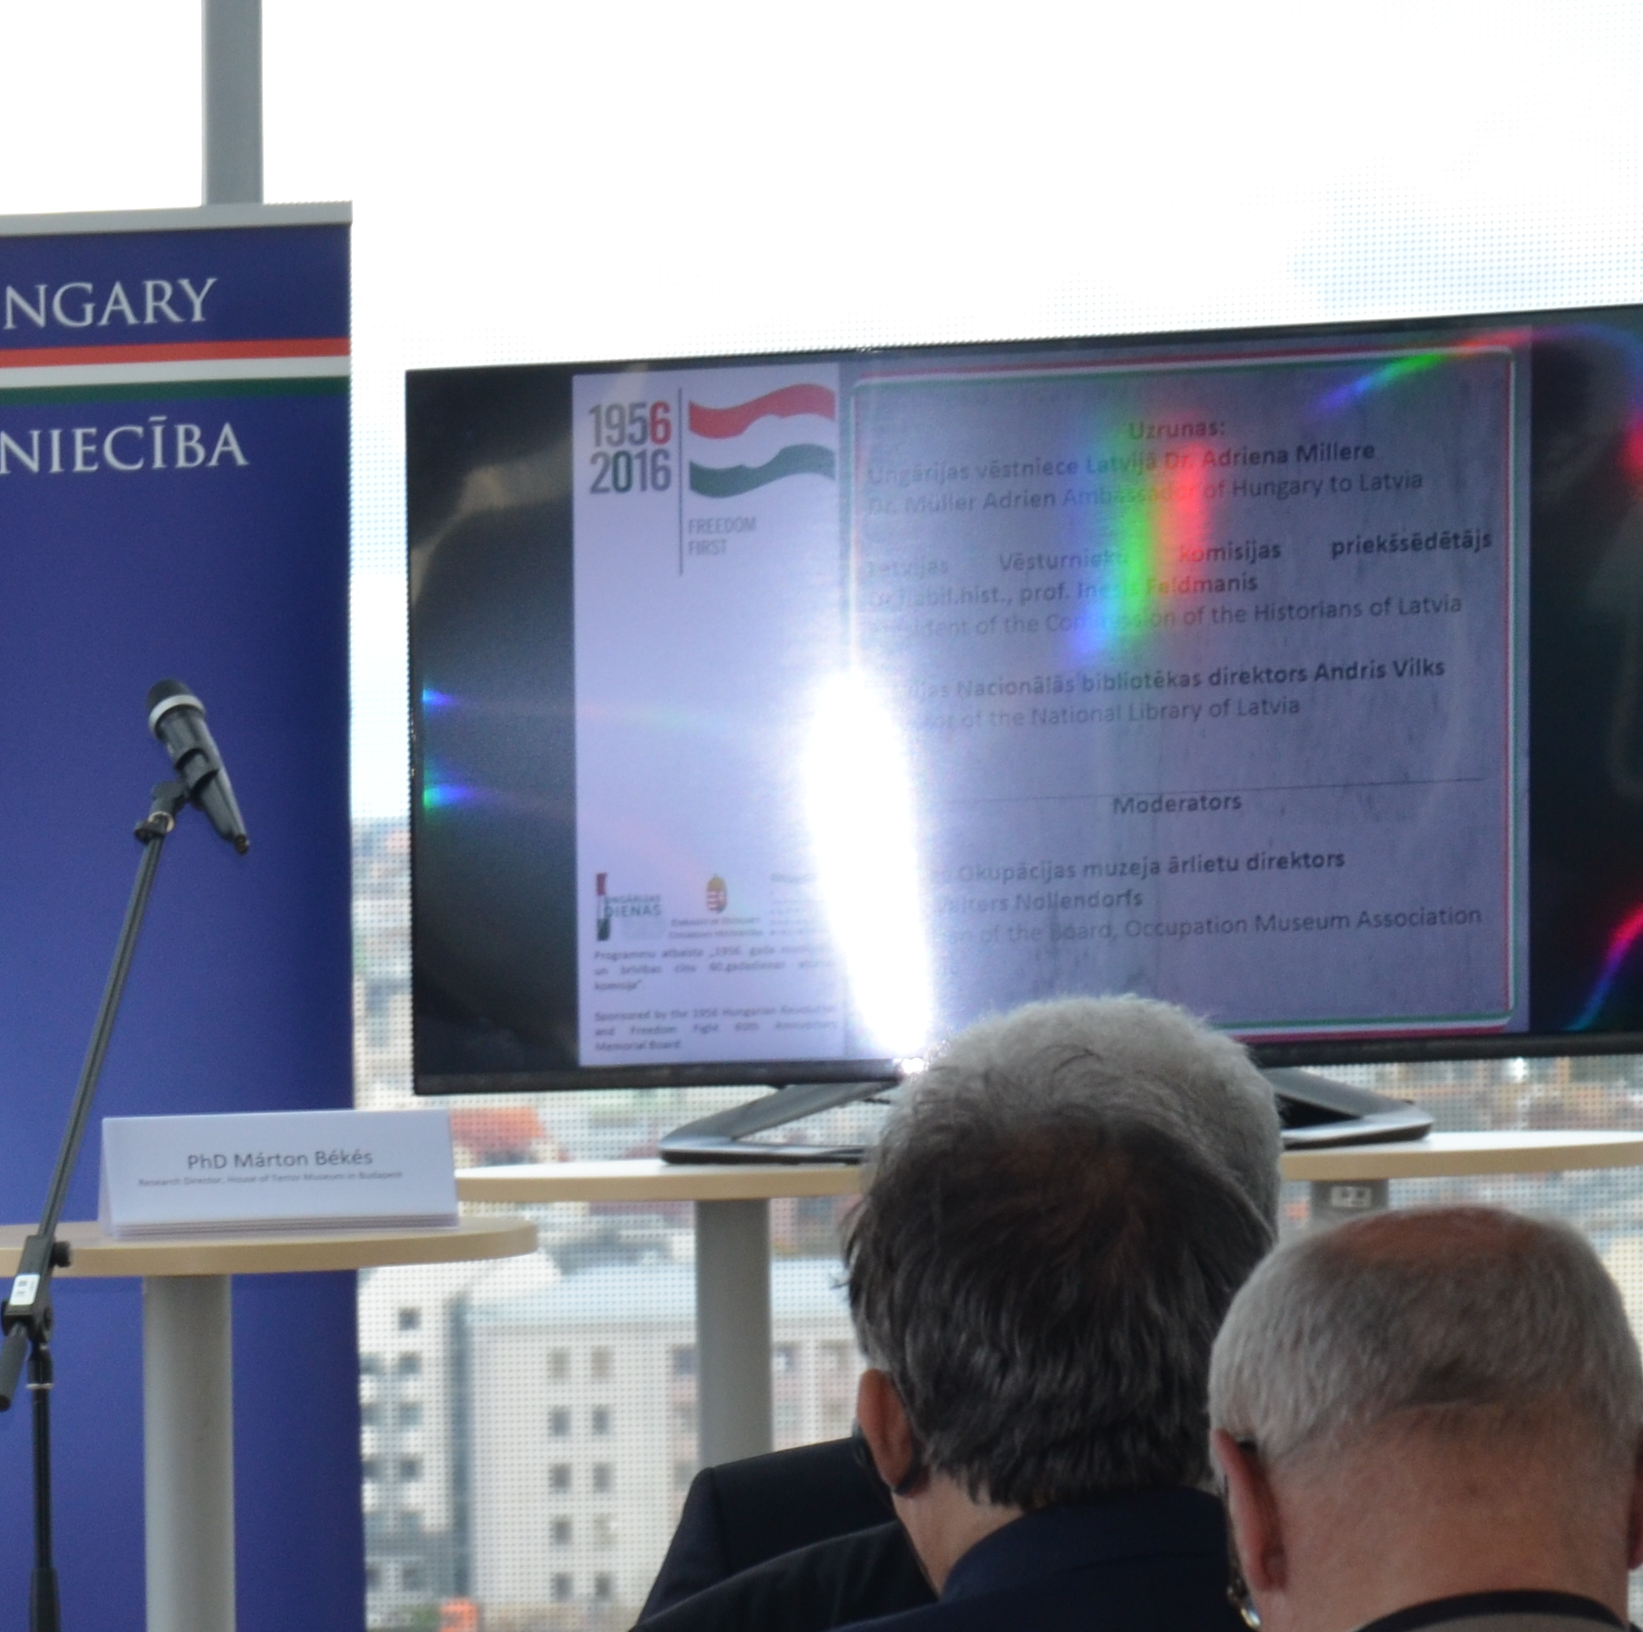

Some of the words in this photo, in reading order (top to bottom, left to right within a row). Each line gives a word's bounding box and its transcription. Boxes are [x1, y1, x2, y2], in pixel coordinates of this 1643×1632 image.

[588, 400, 672, 448] 1956
[1129, 420, 1226, 440] Uzrunas:
[589, 448, 672, 494] 2016
[977, 456, 1079, 479] vēstniece
[1203, 445, 1289, 467] Adriena
[1296, 441, 1376, 463] Millere
[982, 490, 1056, 511] Adrien
[1232, 477, 1324, 501] Hungary
[1330, 475, 1353, 493] to
[1360, 471, 1423, 492] Latvia
[688, 516, 757, 534] FREEDOM
[688, 538, 727, 556] FIRST
[1179, 539, 1281, 565] komisijas
[1020, 581, 1070, 606] prof.
[1183, 606, 1207, 625] of
[1211, 604, 1247, 625] the
[1254, 599, 1363, 623] Historians
[1369, 596, 1392, 617] of
[1398, 593, 1462, 615] Latvia
[1081, 668, 1202, 693] bibliotēkas
[1208, 665, 1308, 687] direktors
[1314, 660, 1388, 682] Andris
[1391, 656, 1446, 679] Vilks
[1031, 701, 1121, 726] National
[1128, 699, 1201, 723] Library
[1208, 698, 1231, 719] of
[1237, 695, 1301, 717] Latvia
[1112, 794, 1243, 815] Moderators
[1082, 856, 1161, 881] muzeja
[1167, 852, 1240, 875] ārlietu
[1246, 850, 1346, 873] direktors
[1124, 914, 1247, 942] Occupation
[1254, 912, 1351, 933] Museum
[1356, 906, 1483, 931] Association
[188, 1153, 228, 1170] PhD
[234, 1151, 309, 1169] Márton
[315, 1148, 374, 1166] Békés
